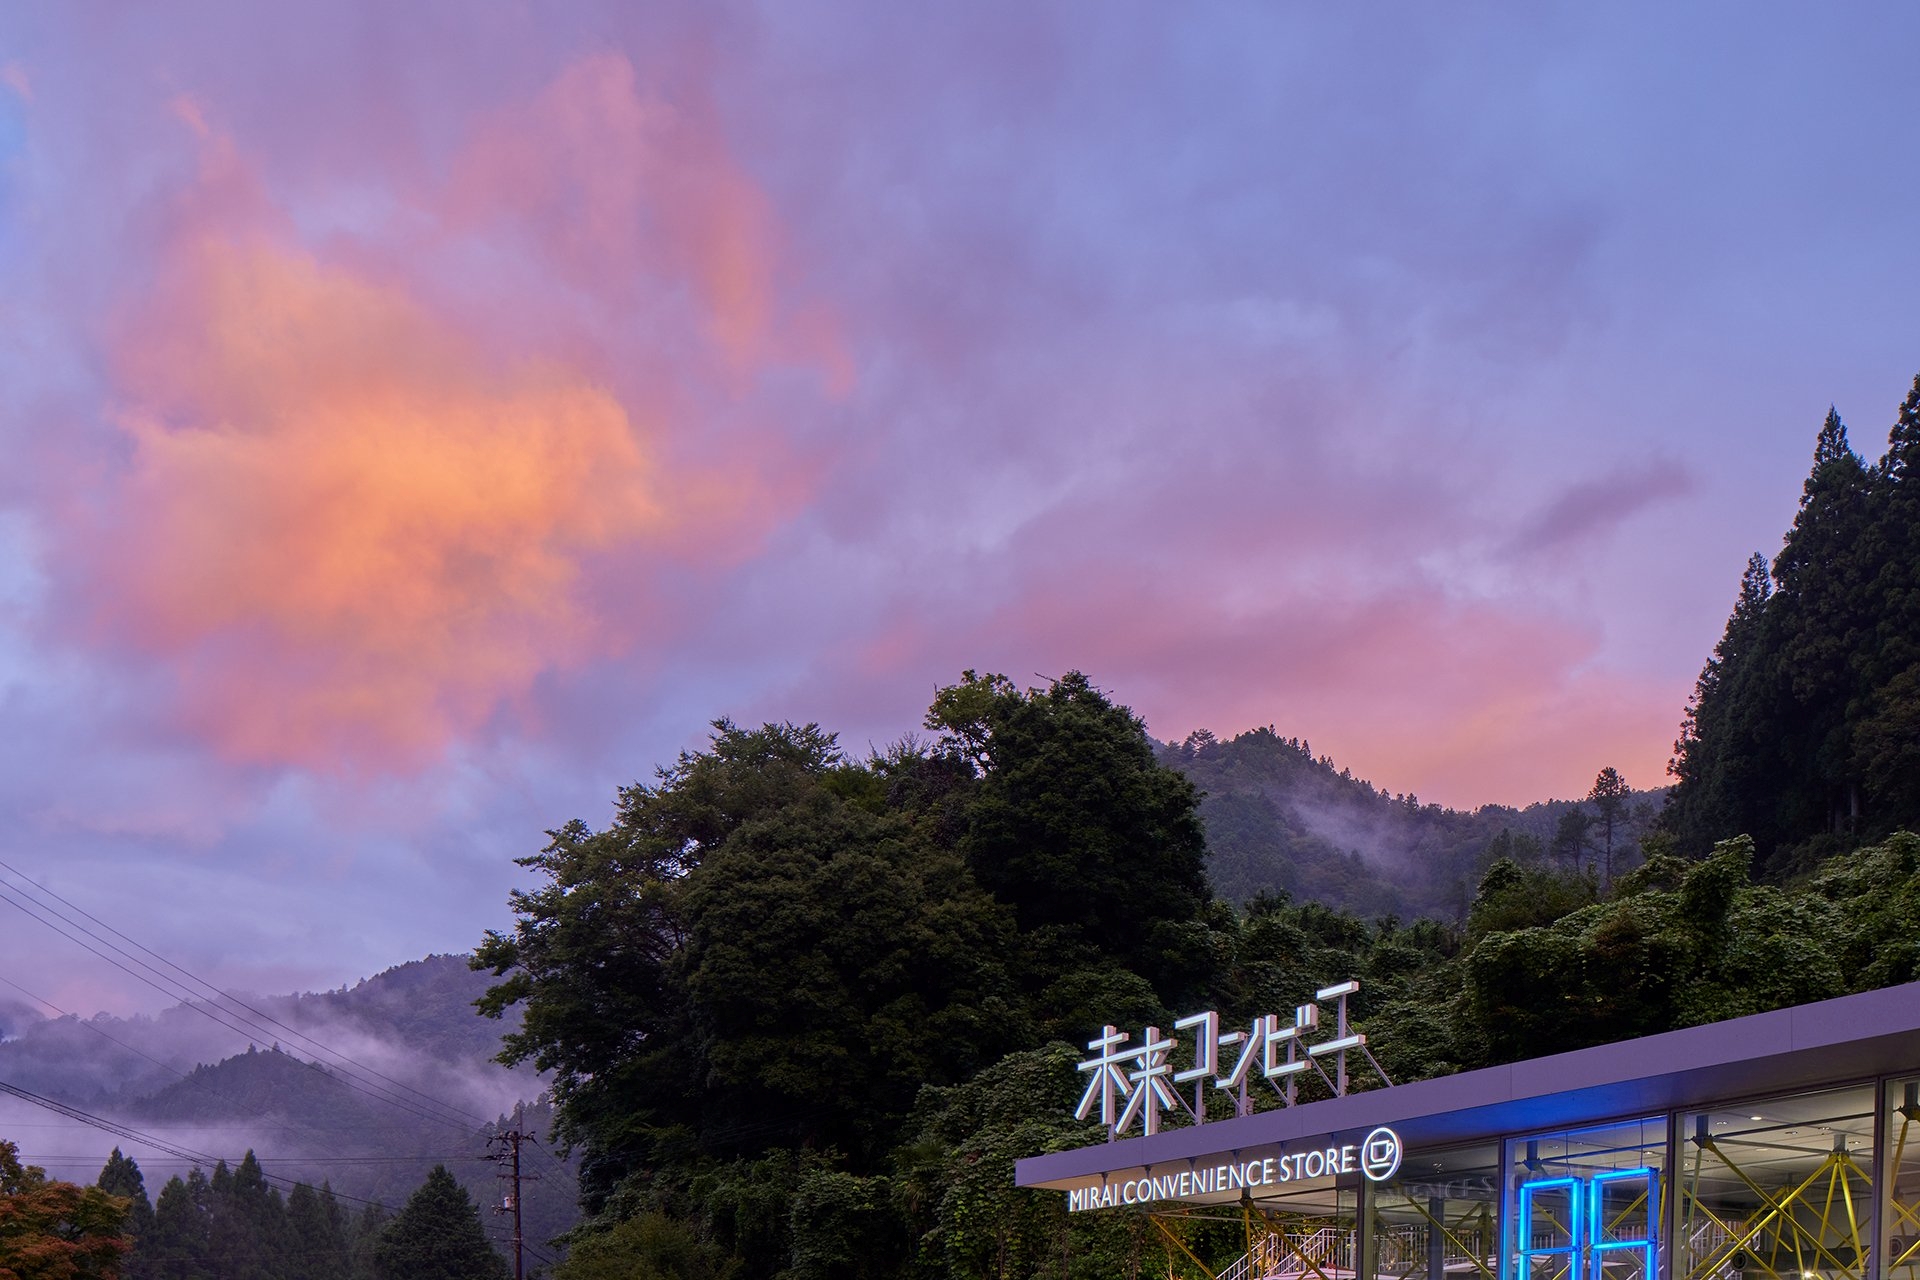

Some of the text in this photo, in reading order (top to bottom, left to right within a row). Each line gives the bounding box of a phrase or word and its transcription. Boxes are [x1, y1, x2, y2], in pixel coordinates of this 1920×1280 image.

[1074, 981, 1366, 1136] 未来コンビニ
[1068, 1145, 1355, 1212] MIRAI CONVENIENCE STORE
